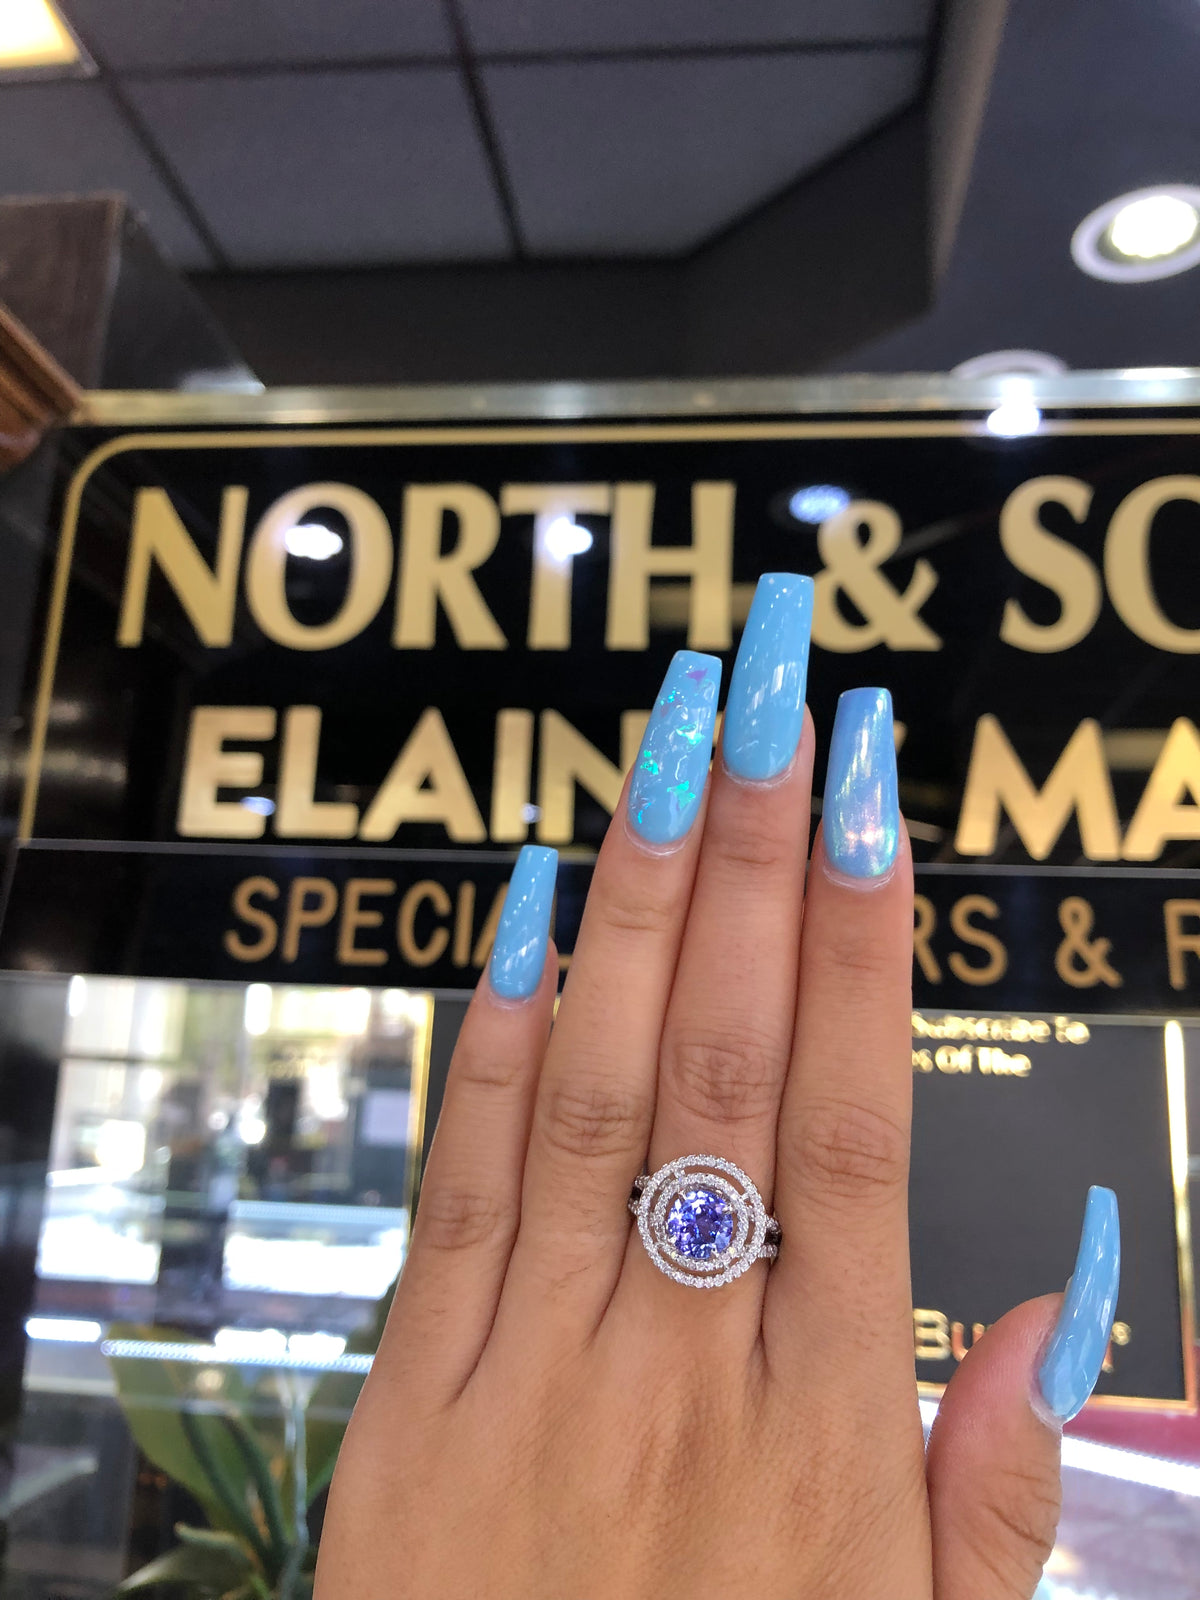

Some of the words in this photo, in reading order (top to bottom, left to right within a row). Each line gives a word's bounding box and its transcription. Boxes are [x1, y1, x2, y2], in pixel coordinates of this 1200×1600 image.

[117, 480, 737, 652] NORTH
[810, 499, 943, 653] &
[177, 705, 720, 844] ELAIN
[1054, 896, 1124, 990] &
